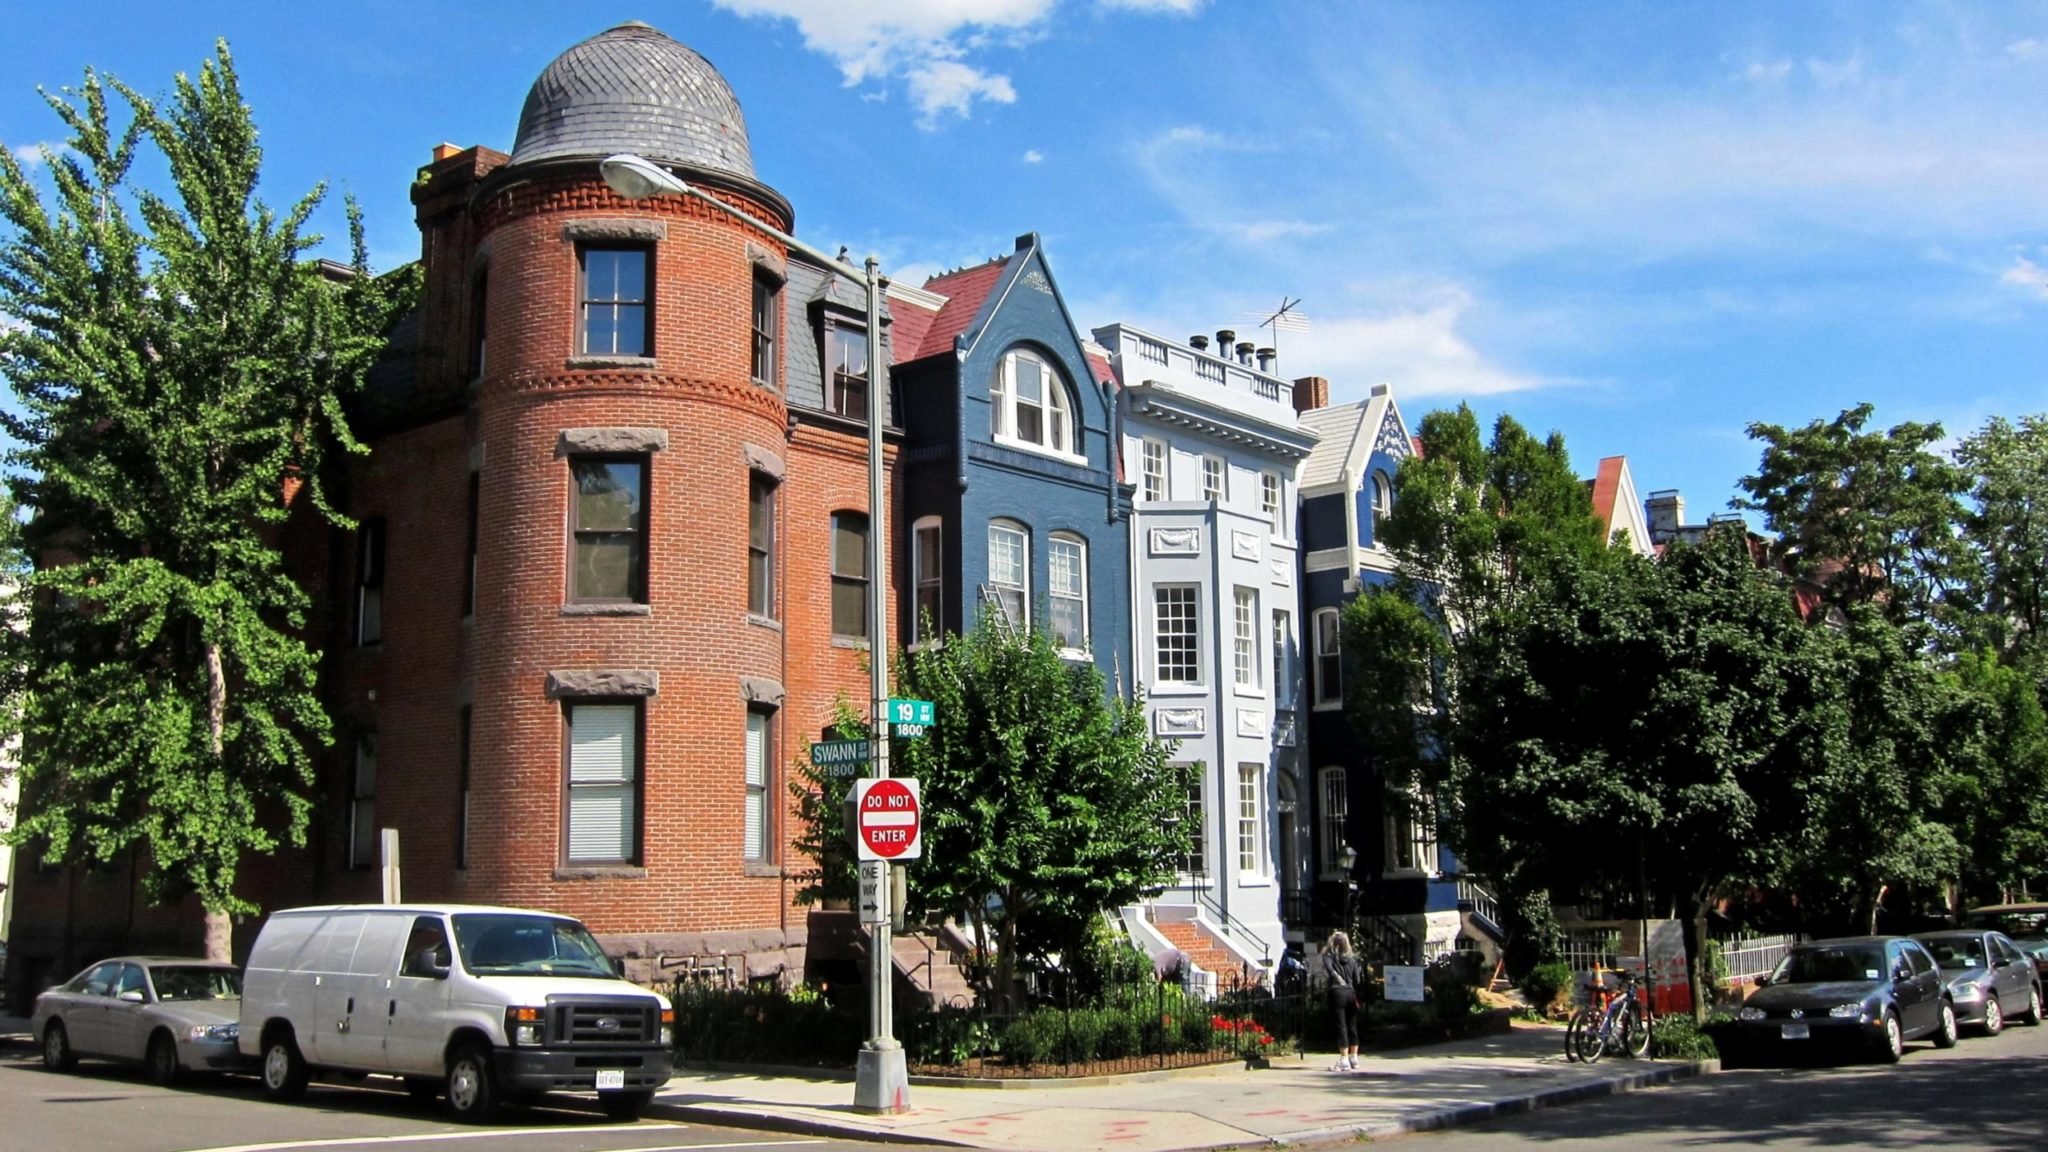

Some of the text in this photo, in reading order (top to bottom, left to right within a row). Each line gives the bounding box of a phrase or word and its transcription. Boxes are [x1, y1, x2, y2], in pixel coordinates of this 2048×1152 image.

[896, 703, 930, 721] 19 ST
[897, 723, 923, 737] 1800
[814, 742, 867, 764] SWANN ST
[828, 763, 855, 777] 1800
[867, 795, 910, 808] DO NOT
[872, 829, 906, 843] ENTER
[862, 867, 879, 880] ONE
[862, 883, 878, 896] WAY
